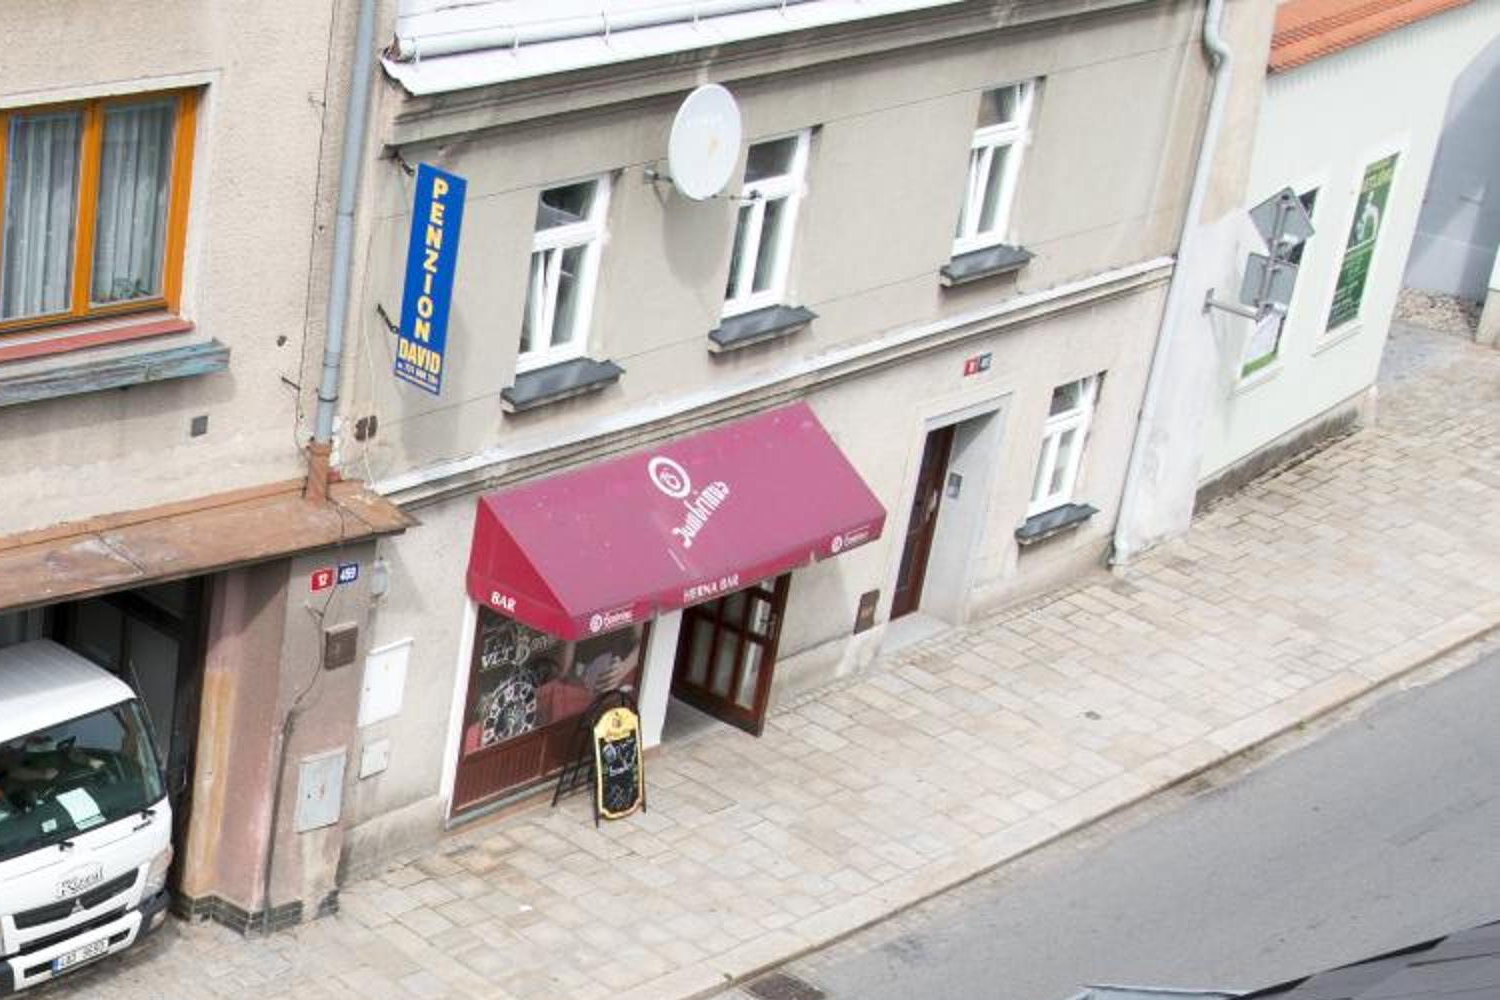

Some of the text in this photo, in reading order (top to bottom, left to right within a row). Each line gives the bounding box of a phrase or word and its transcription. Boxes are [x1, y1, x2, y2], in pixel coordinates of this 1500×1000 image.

[413, 177, 449, 343] PENZION
[398, 337, 441, 375] DAVID
[490, 590, 517, 614] BAR
